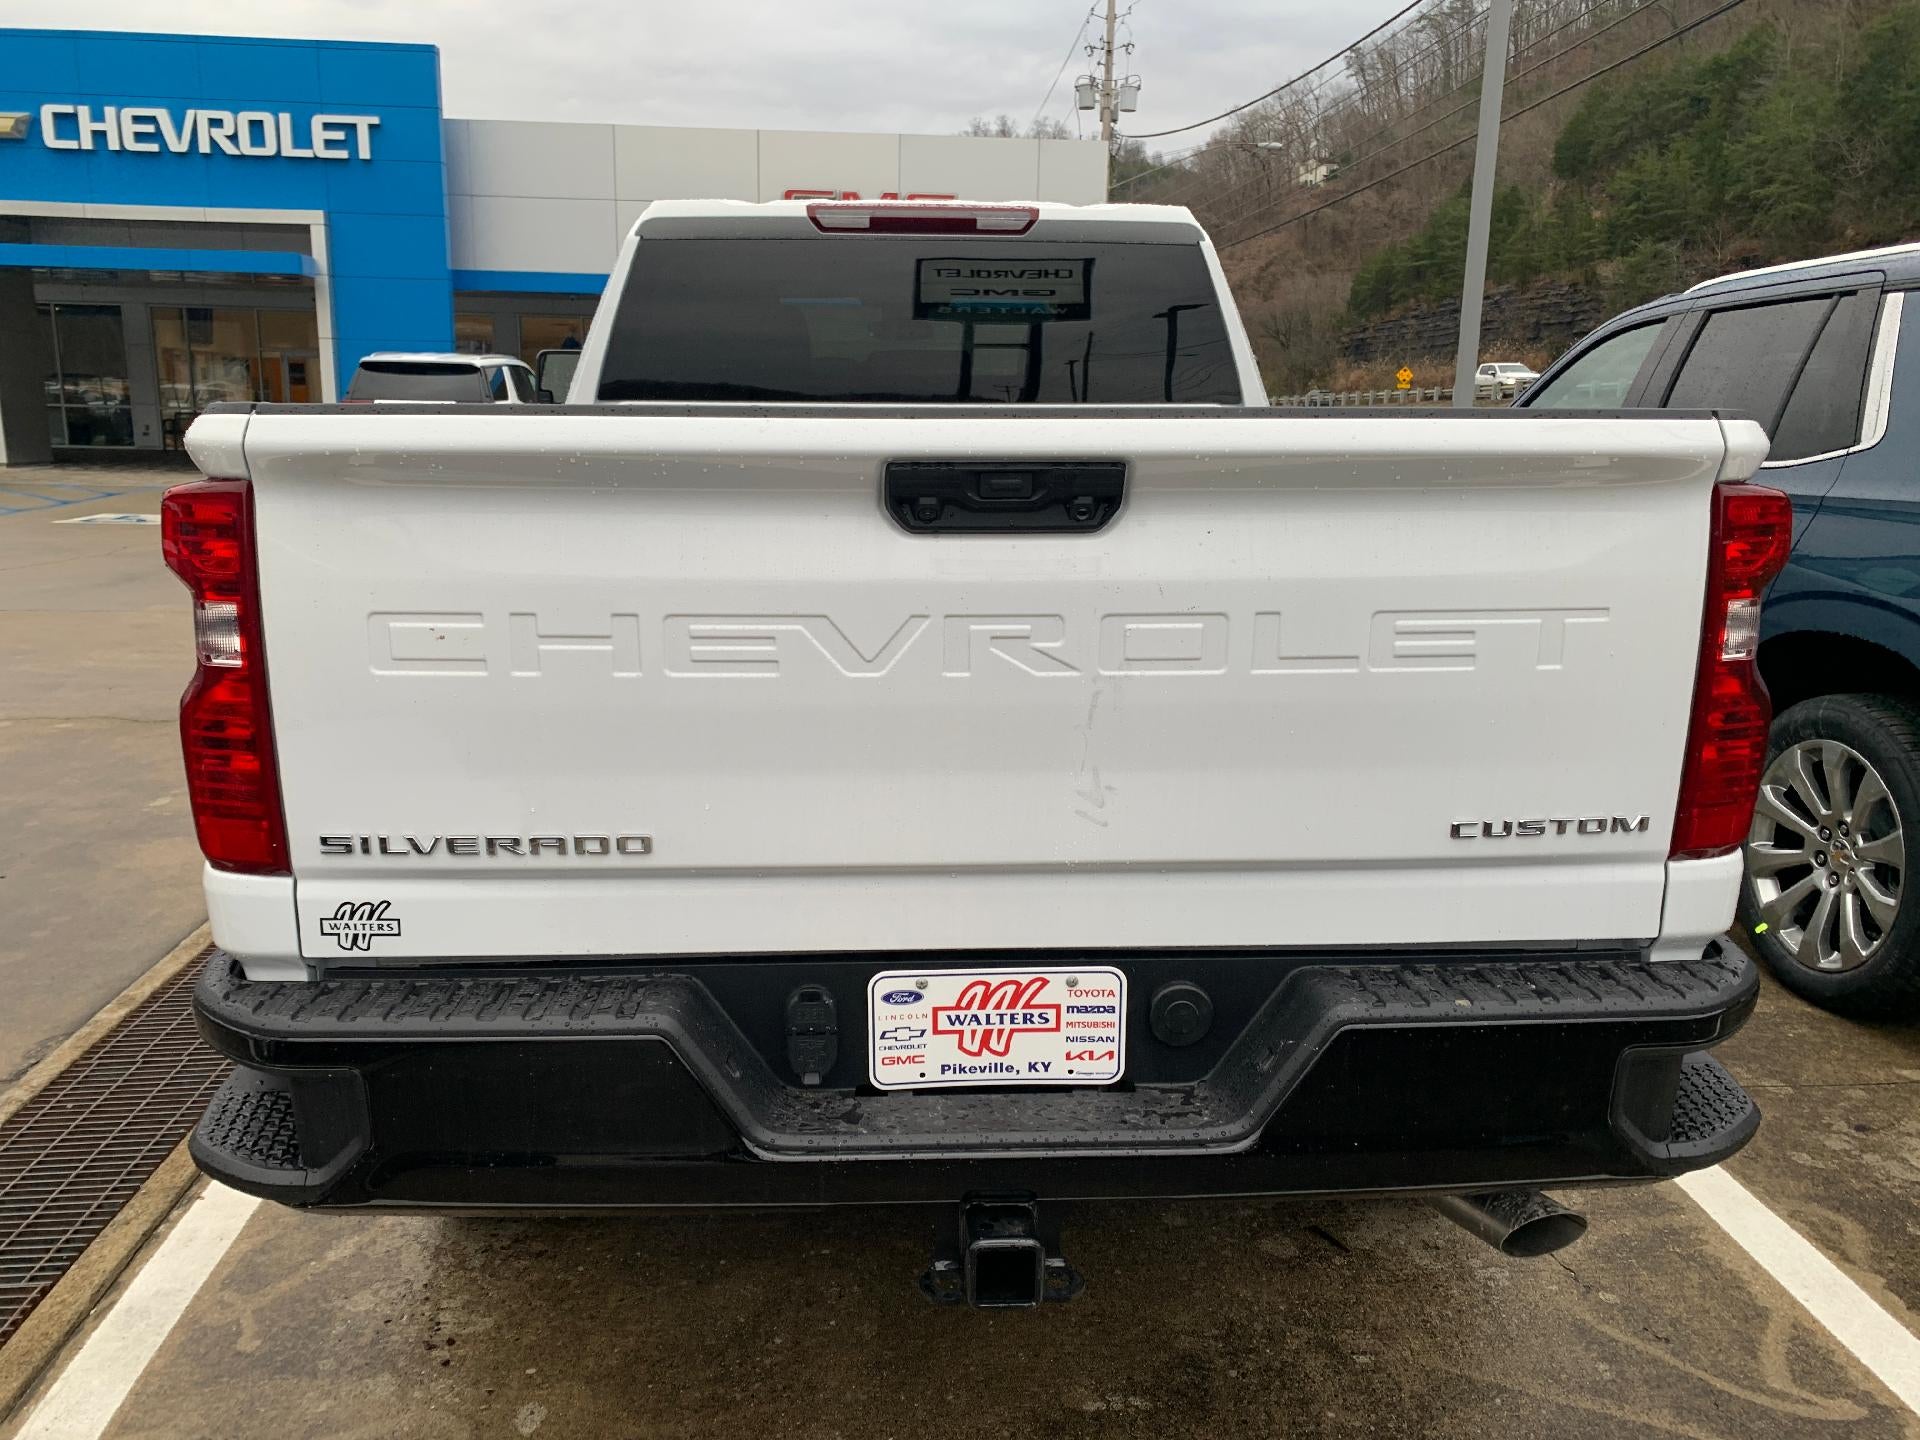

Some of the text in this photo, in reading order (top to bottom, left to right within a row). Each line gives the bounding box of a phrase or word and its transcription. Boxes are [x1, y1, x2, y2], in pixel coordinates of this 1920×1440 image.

[40, 103, 381, 160] CHEVROLET
[367, 607, 1610, 678] CHEVROLET
[1450, 814, 1651, 839] CUSTOM
[319, 833, 654, 857] SILVERADO
[328, 922, 394, 932] WALTERS
[889, 992, 916, 1004] Ford
[1066, 988, 1116, 999] TOYOTA
[878, 1012, 928, 1022] LINCOLN
[946, 1011, 1051, 1027] WALTERS
[1065, 1020, 1116, 1030] MITSUBISHI
[1065, 1035, 1116, 1044] NISSAN
[878, 1043, 928, 1052] CHEVROLET
[881, 1054, 926, 1067] GMC
[1065, 1050, 1115, 1061] KIA
[940, 1061, 1052, 1076] Pikeville, KY
